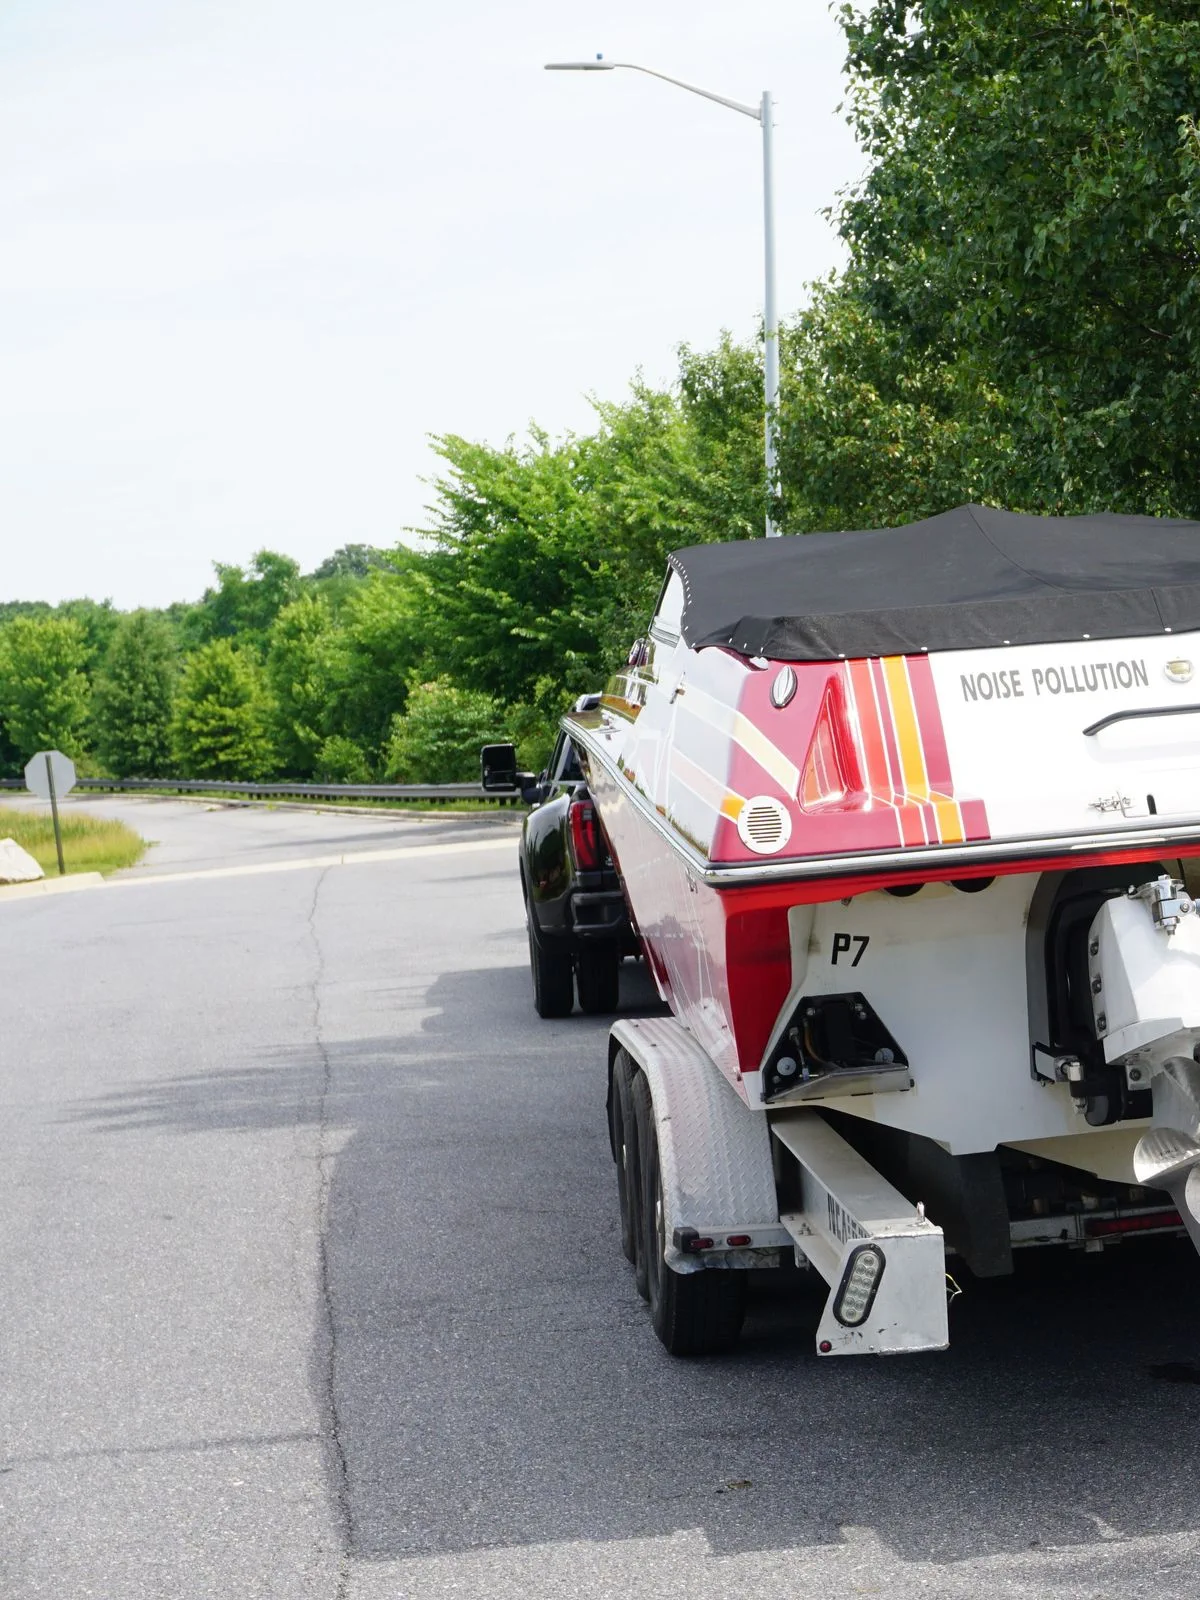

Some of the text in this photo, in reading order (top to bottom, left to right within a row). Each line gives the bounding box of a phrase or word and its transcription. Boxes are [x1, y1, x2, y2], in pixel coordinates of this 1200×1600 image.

[960, 659, 1150, 702] NOISE POLLUTION
[831, 933, 870, 967] P7
